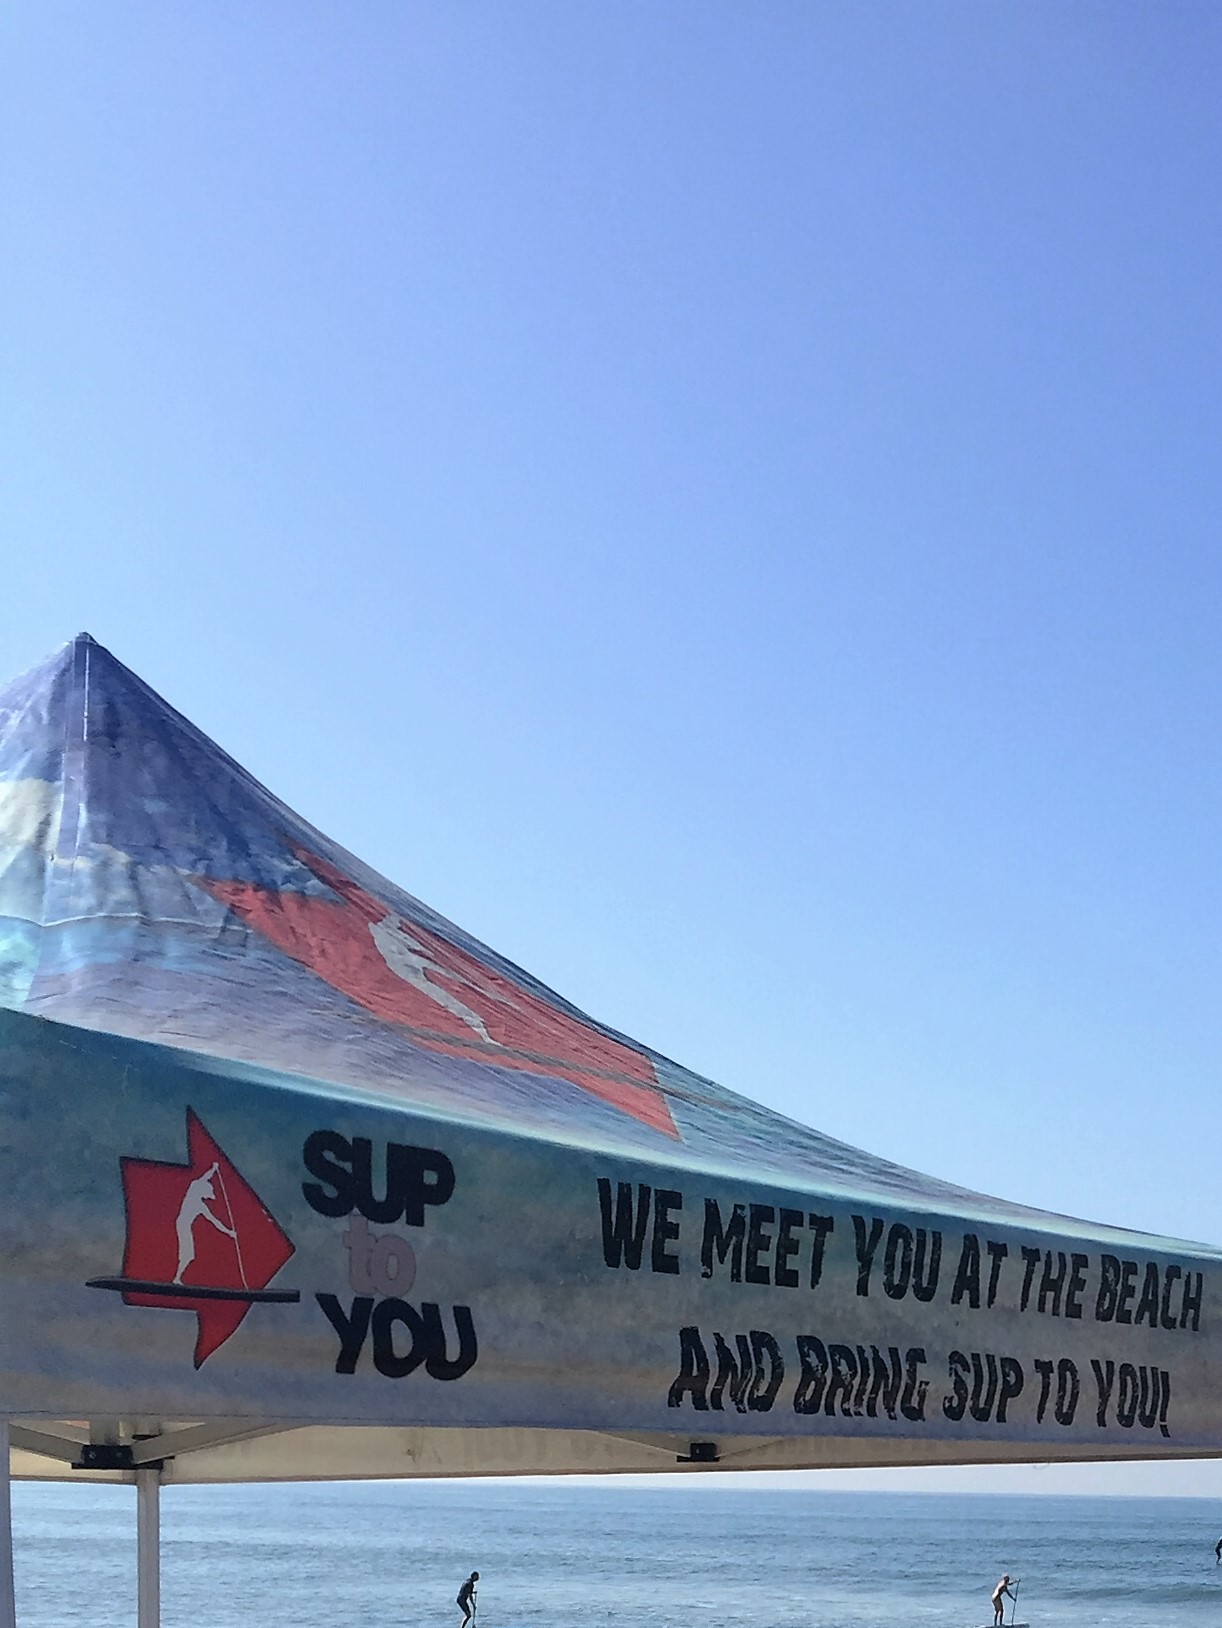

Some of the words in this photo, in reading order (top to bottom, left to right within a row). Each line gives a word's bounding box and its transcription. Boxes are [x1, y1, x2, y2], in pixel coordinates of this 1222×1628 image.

[302, 1130, 455, 1227] SUP
[343, 1215, 417, 1298] to
[597, 1178, 683, 1275] WE
[701, 1198, 834, 1290] MEET
[851, 1215, 943, 1303] YOU
[950, 1233, 1008, 1309] AT
[1020, 1245, 1089, 1320] THE
[1095, 1253, 1204, 1332] BEACH
[315, 1293, 478, 1381] YOU
[668, 1325, 785, 1414] AND
[793, 1335, 930, 1422] BRING
[942, 1350, 1024, 1424] SUP
[1034, 1358, 1081, 1427] TO
[1091, 1359, 1171, 1438] YOU!
